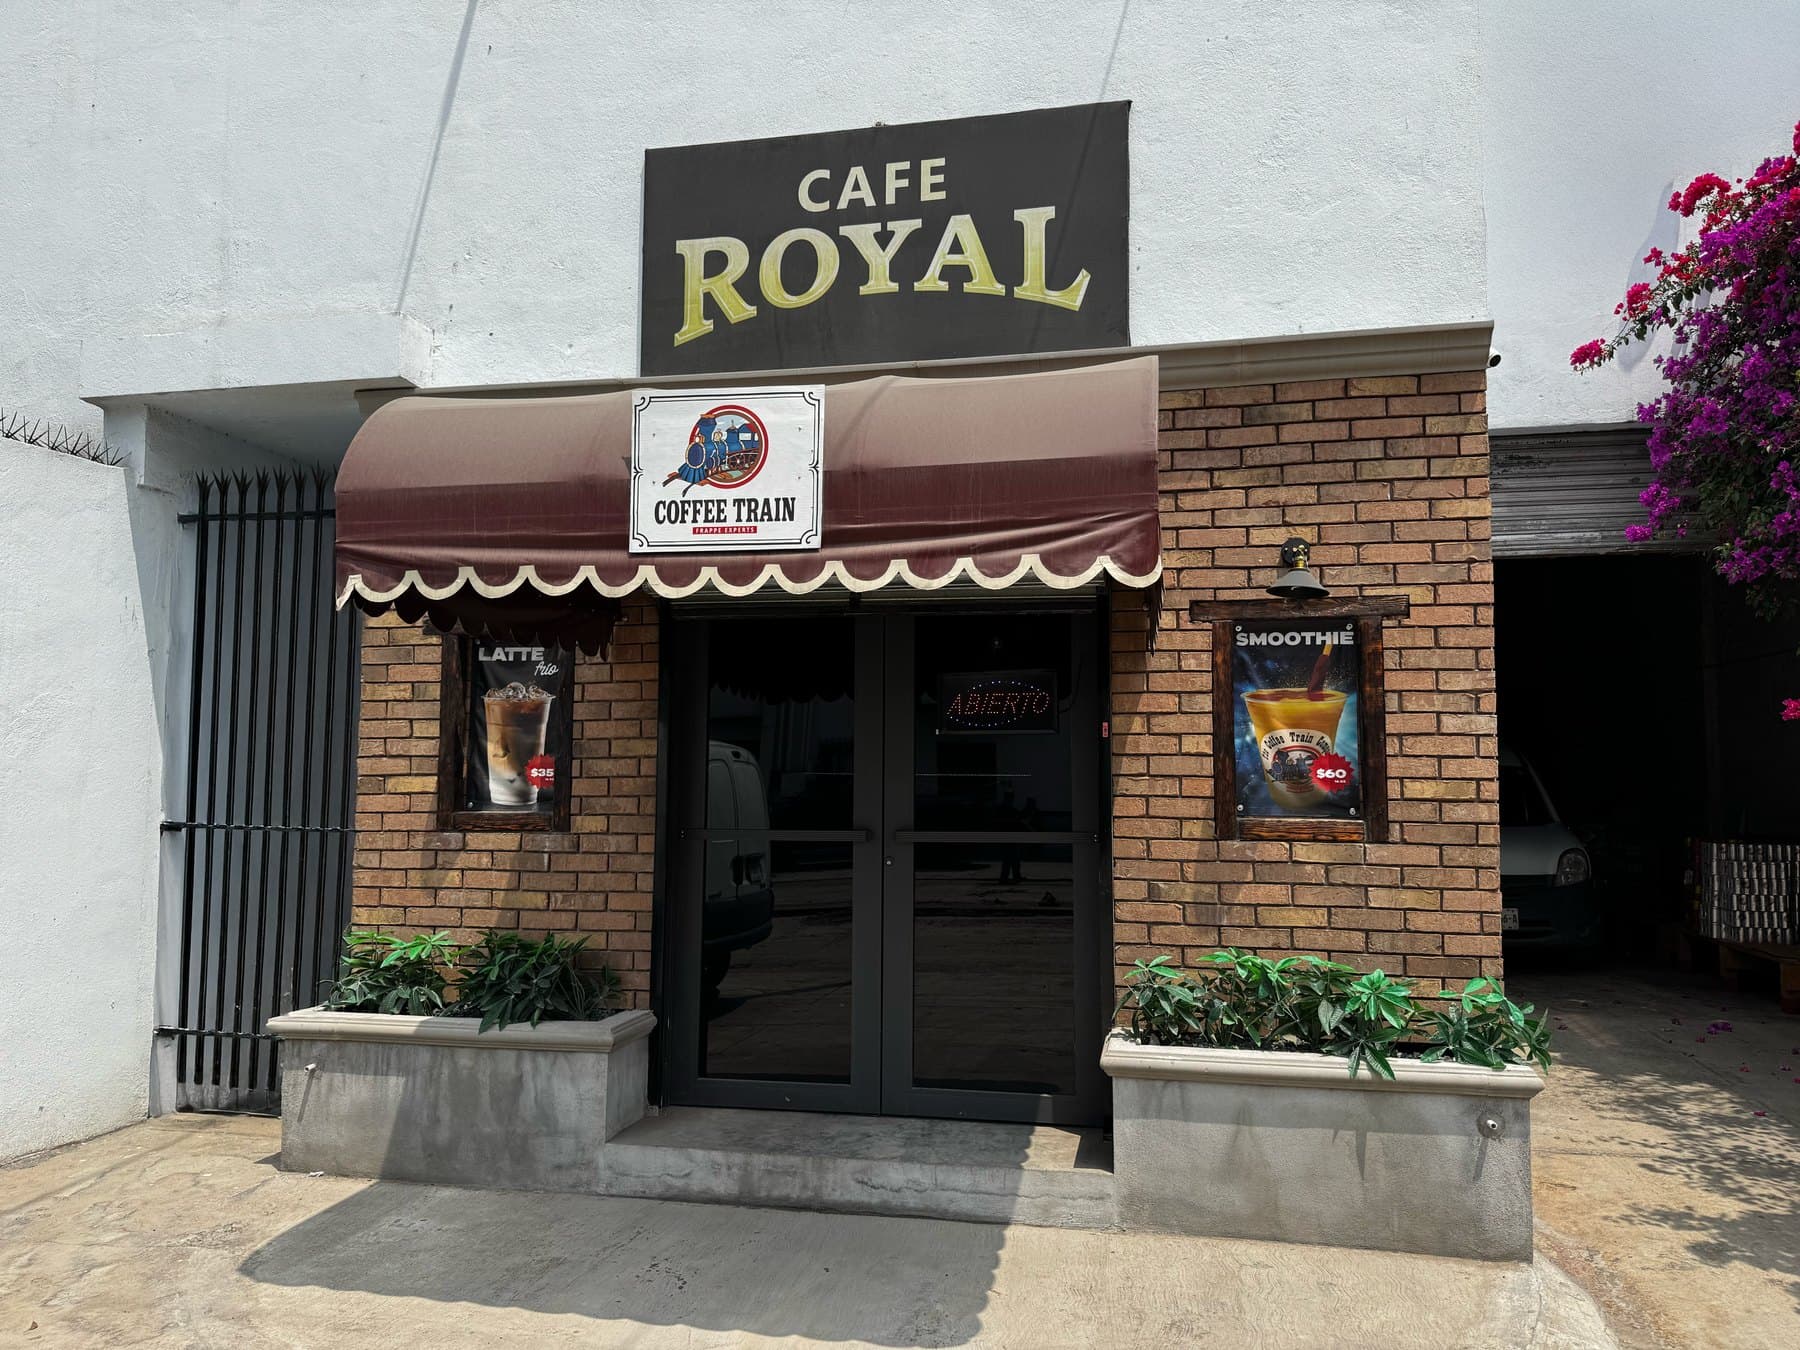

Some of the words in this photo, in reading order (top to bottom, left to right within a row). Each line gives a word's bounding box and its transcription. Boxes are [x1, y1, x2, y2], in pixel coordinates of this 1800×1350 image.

[798, 157, 946, 213] CAFE
[674, 206, 1091, 347] ROYAL
[654, 498, 728, 525] COFFEE
[733, 497, 796, 523] TRAIN
[695, 527, 721, 535] FRAPPE
[724, 526, 755, 534] EXPERTS
[1236, 631, 1354, 646] SMOOTHIE
[478, 647, 545, 662] LATTE
[1289, 732, 1314, 744] Train
[530, 768, 554, 778] $35
[1316, 768, 1347, 779] $60
